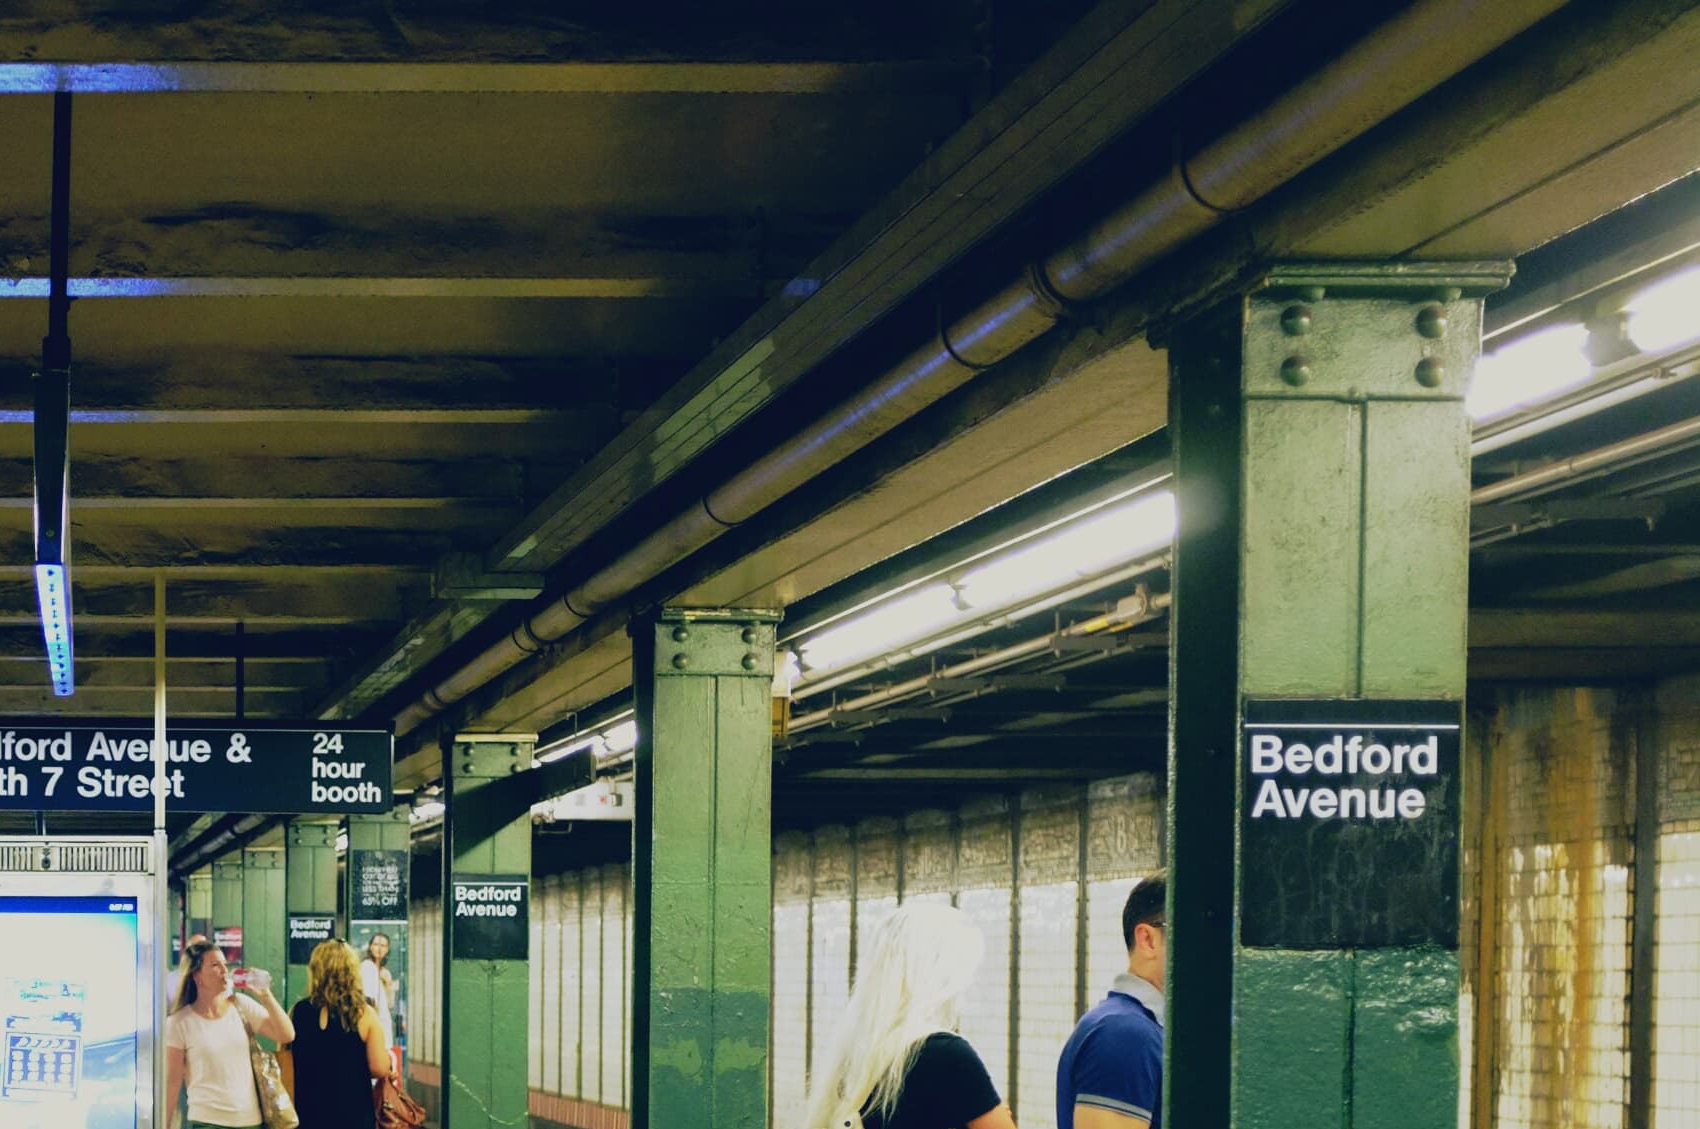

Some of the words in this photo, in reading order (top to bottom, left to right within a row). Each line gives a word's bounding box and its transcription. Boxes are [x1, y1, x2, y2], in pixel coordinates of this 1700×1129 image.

[226, 732, 252, 763] &
[312, 732, 343, 755] 24
[1251, 734, 1439, 775] Bedford
[311, 757, 366, 779] hour
[41, 767, 64, 797] 7
[77, 766, 185, 799] Street
[311, 782, 382, 803] booth
[1251, 779, 1426, 819] Avenue
[455, 886, 522, 902] Bedford
[455, 901, 518, 917] Avenue
[291, 919, 332, 930] Bedford
[291, 929, 329, 939] Avenue
